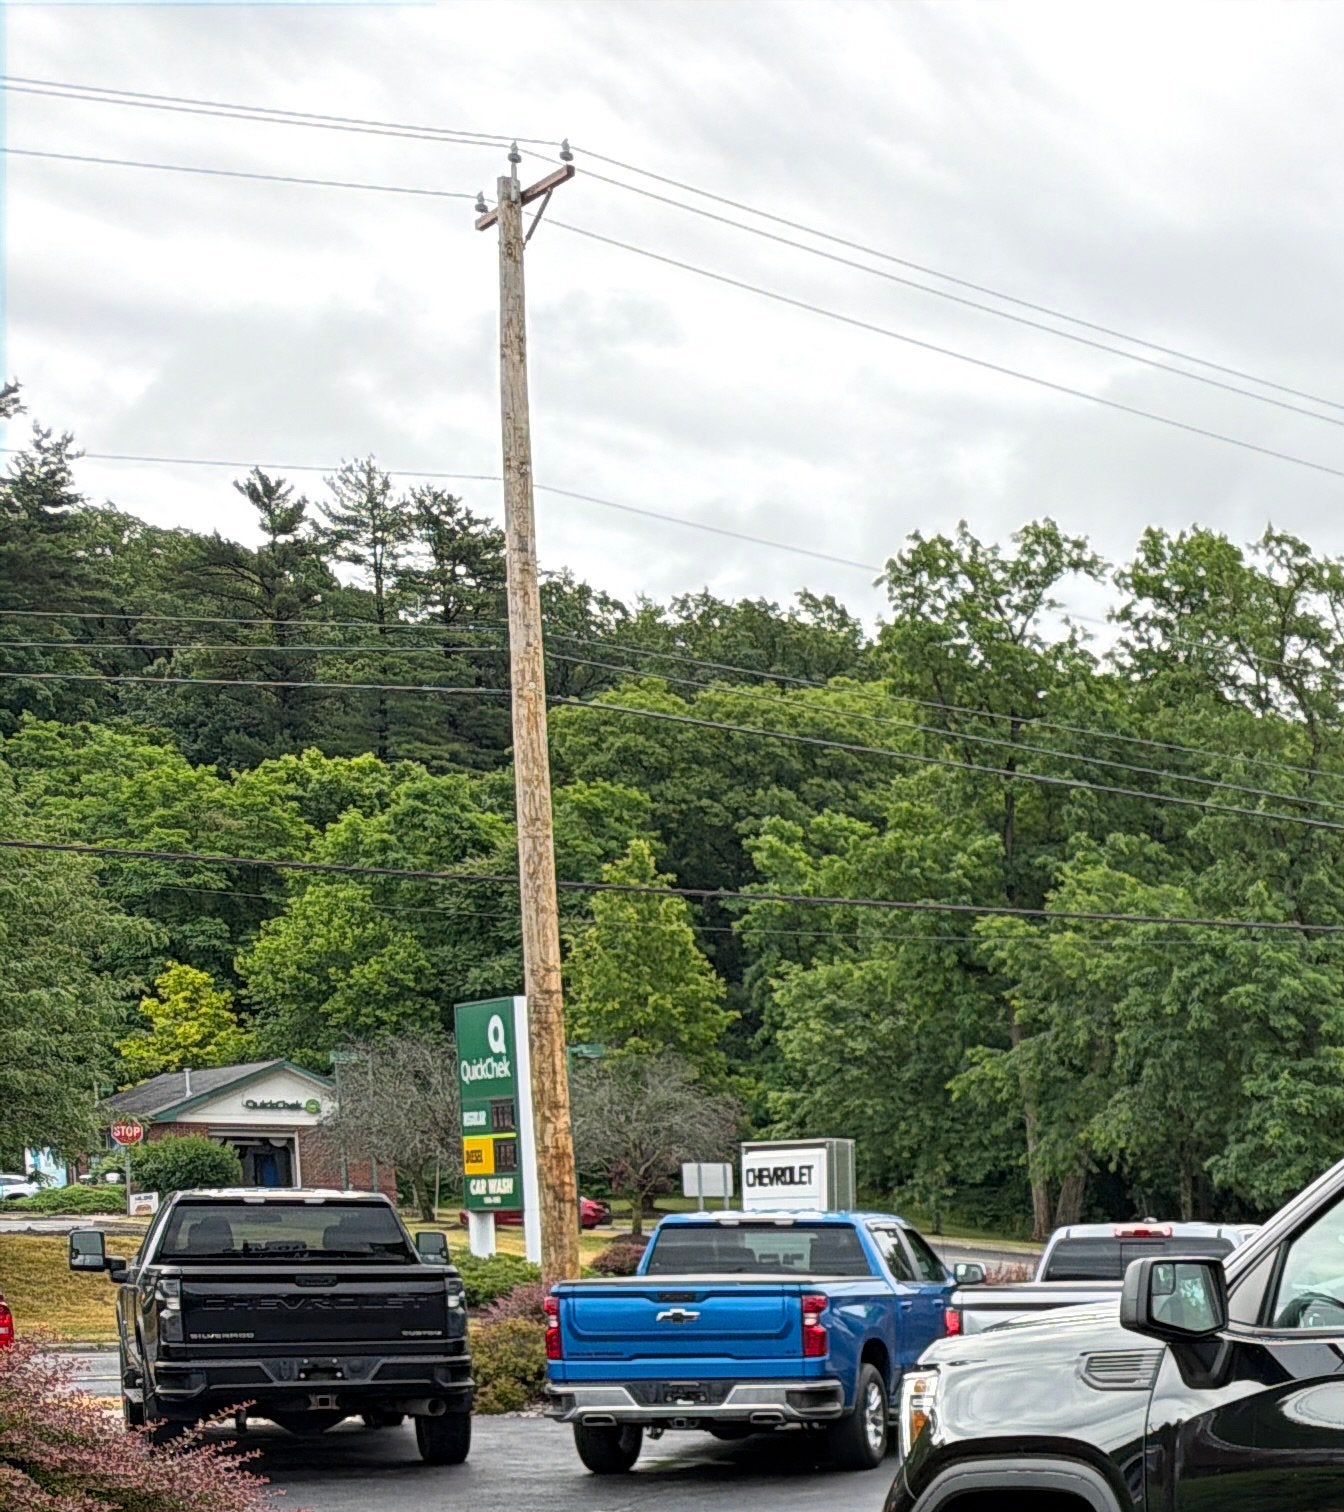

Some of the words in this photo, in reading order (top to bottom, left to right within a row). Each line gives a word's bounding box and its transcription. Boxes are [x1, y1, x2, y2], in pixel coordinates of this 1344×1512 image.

[461, 1056, 511, 1085] QuickChek
[113, 1125, 141, 1137] STOP
[746, 1164, 814, 1187] CHEVROLET
[470, 1178, 487, 1195] CAR
[488, 1177, 514, 1194] WASH
